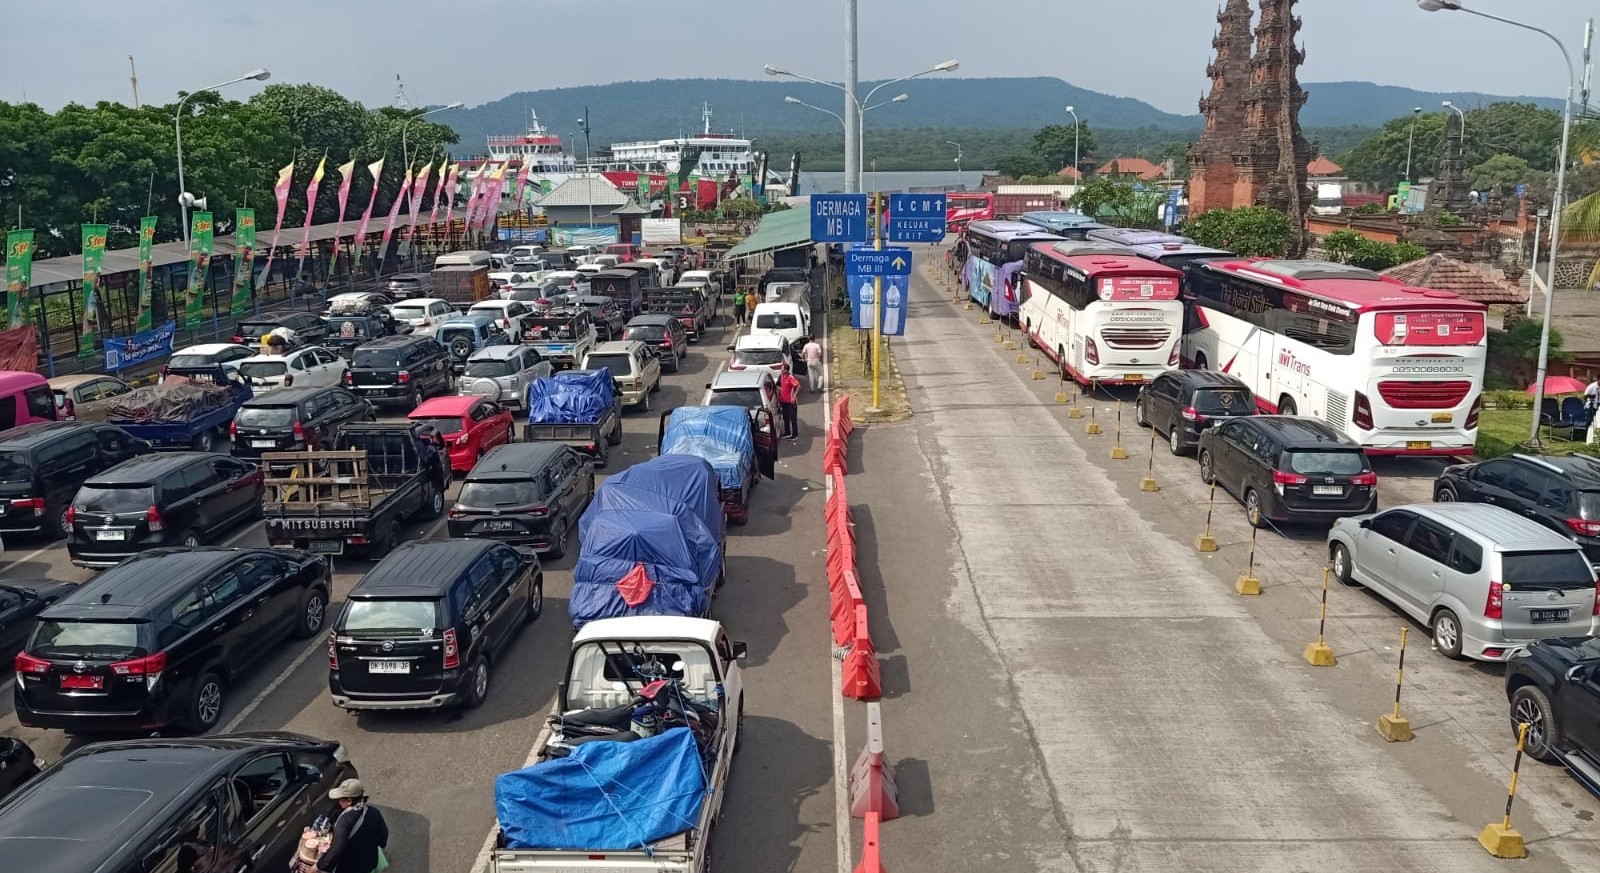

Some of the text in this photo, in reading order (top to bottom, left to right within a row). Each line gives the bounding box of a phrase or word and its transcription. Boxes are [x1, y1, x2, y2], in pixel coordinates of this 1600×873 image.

[680, 197, 687, 208] 3
[816, 200, 860, 216] DERMAGA
[827, 218, 843, 236] MB
[897, 221, 929, 229] KELUAR
[898, 232, 922, 240] EXIT
[851, 254, 890, 264] Dermaga
[857, 265, 883, 273] MB III
[282, 520, 355, 530] MITSUBISHI
